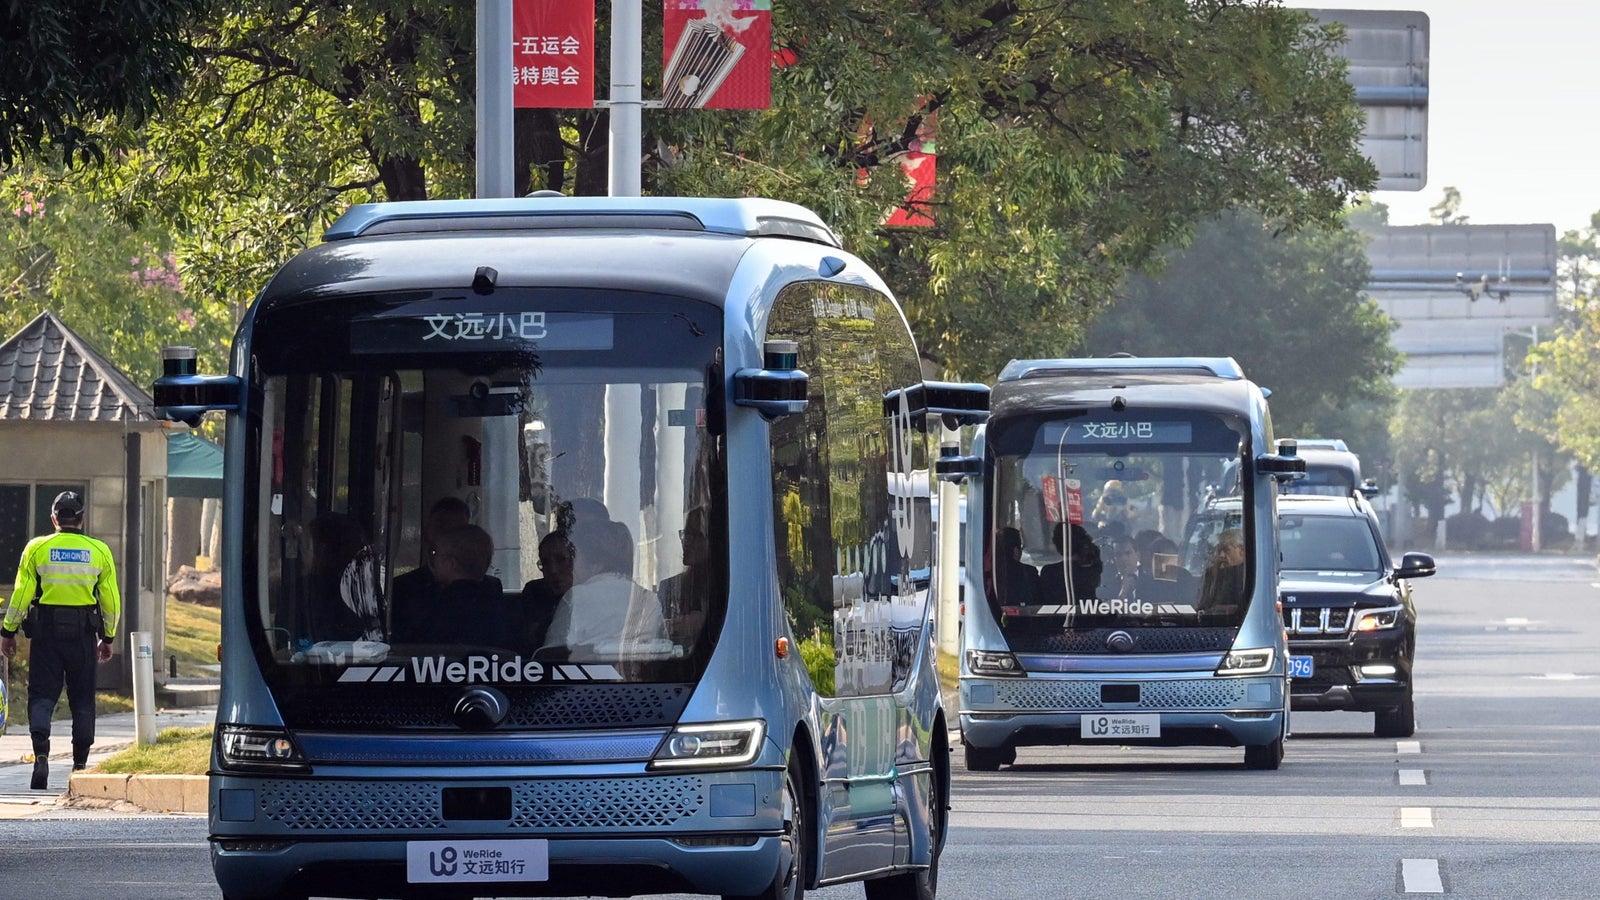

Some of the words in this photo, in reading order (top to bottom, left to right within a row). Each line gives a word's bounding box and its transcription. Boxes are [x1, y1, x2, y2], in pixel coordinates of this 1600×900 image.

[421, 311, 548, 341] 文远小巴
[1082, 421, 1153, 439] 文远小巴
[1079, 598, 1154, 615] WeRide
[411, 654, 544, 683] WeRide
[1111, 724, 1150, 735] 文远知行
[463, 849, 503, 859] WeRide
[463, 859, 526, 875] 文远知行
